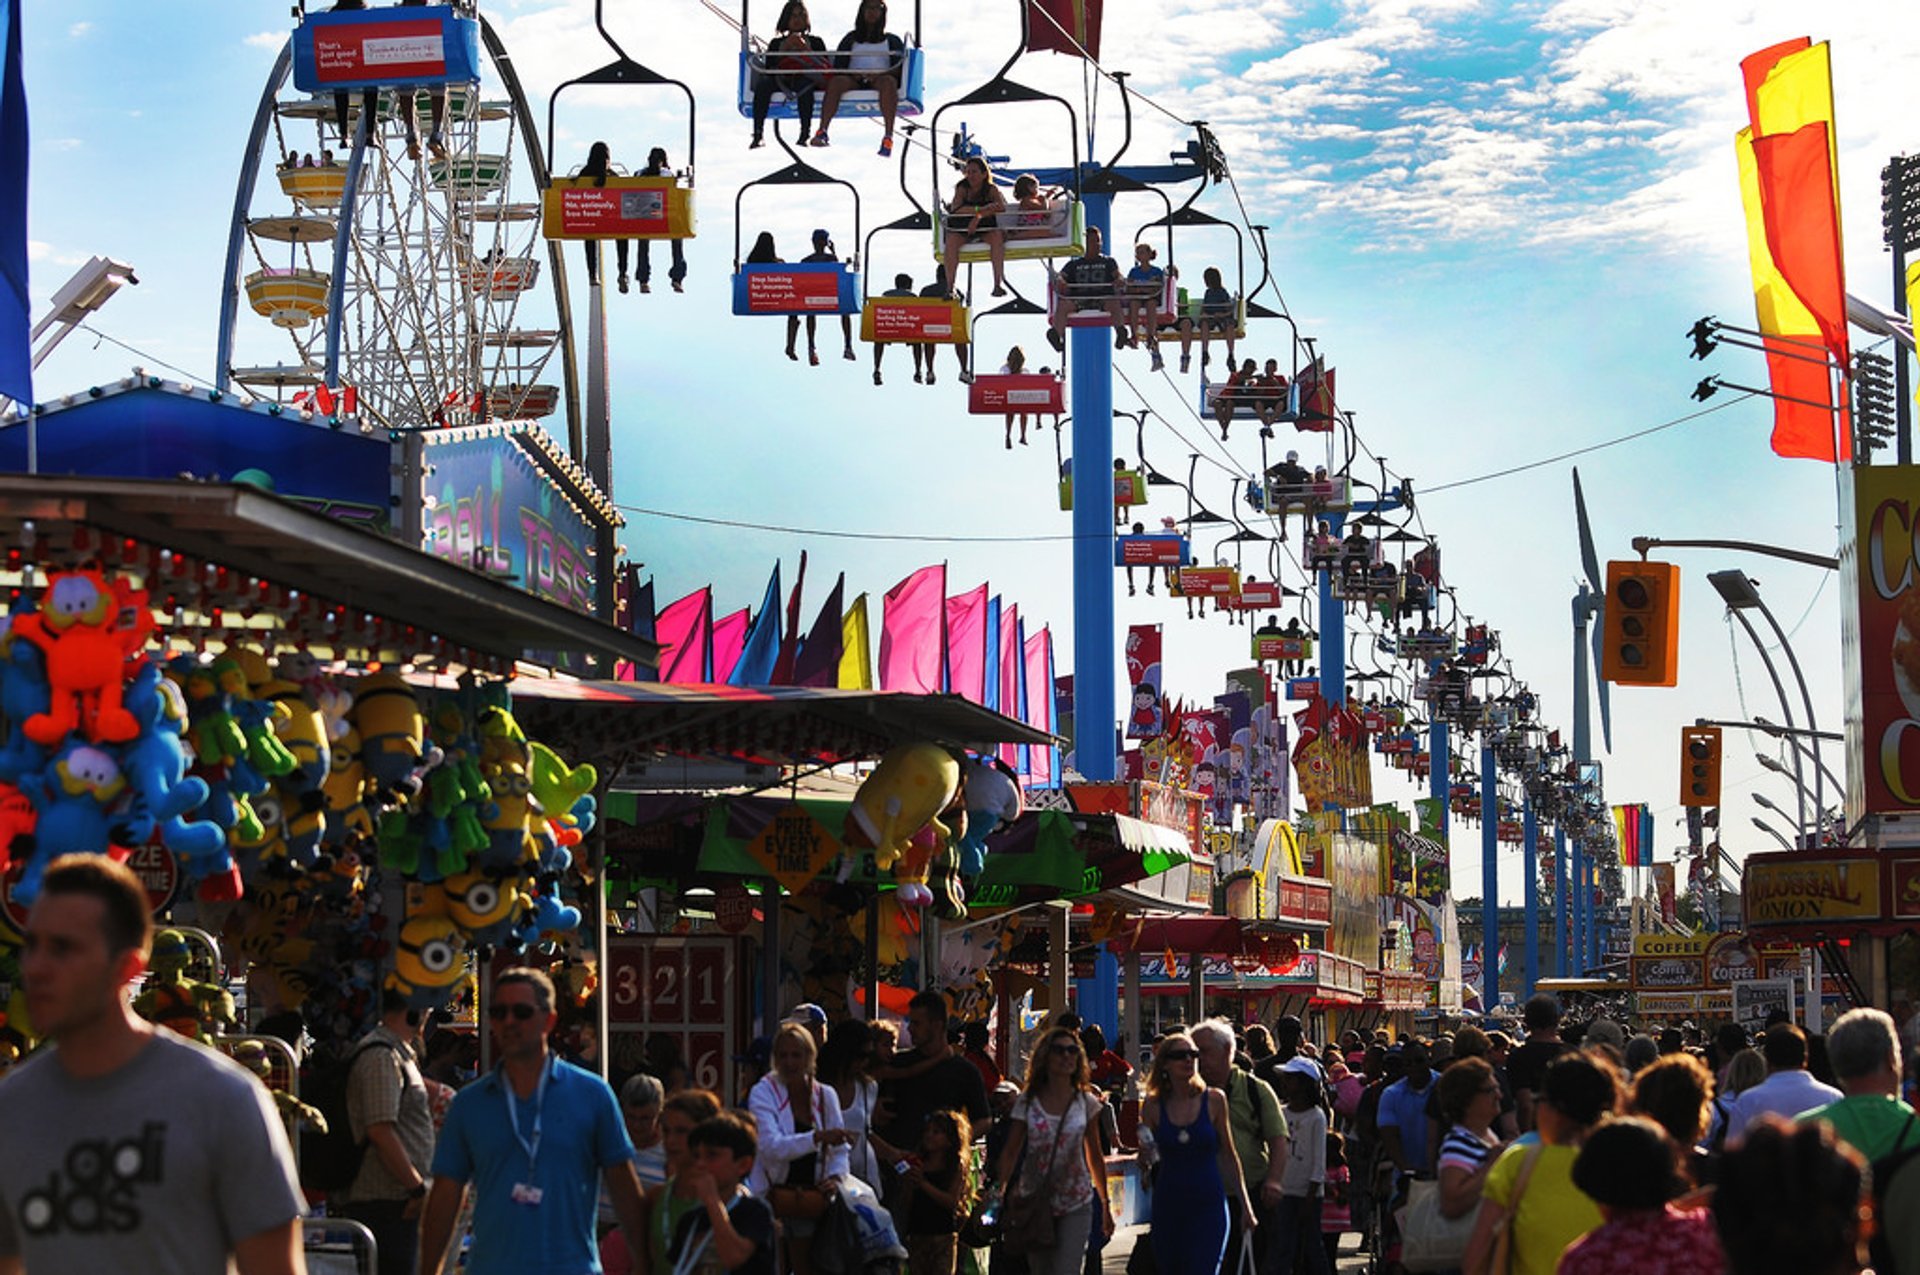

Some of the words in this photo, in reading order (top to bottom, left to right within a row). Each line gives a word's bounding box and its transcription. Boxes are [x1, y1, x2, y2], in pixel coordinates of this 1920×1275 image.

[432, 484, 511, 576] BALL
[519, 506, 590, 611] TOSS
[776, 817, 812, 834] PRIZE
[765, 836, 820, 853] EVERY
[776, 854, 809, 871] TIME
[1759, 900, 1823, 918] ONION
[1643, 942, 1702, 954] COFFEE
[1711, 967, 1756, 980] COFFEE
[615, 965, 637, 1004] 3
[654, 965, 678, 1005] 2
[698, 965, 717, 1005] 1
[695, 1050, 718, 1089] 6
